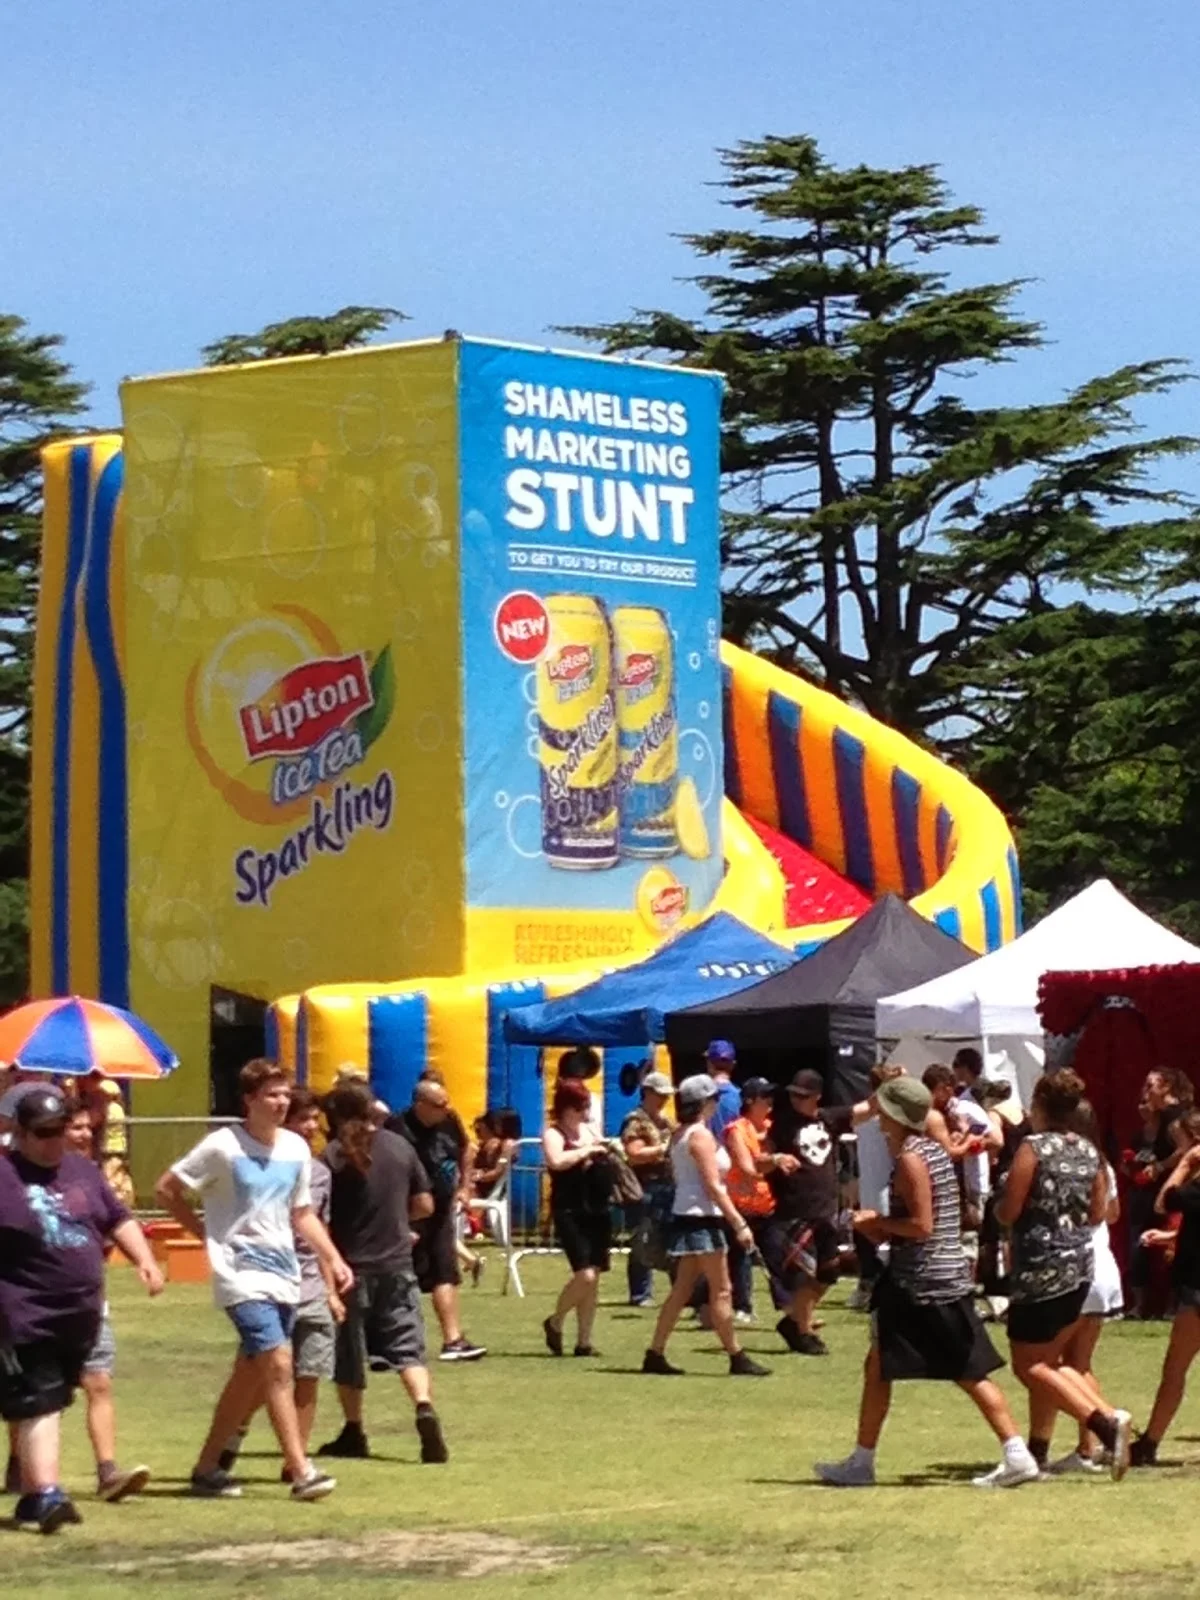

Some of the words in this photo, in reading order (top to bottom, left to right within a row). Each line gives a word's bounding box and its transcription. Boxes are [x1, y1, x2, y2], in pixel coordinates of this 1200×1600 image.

[504, 381, 688, 437] SHAMELESS
[505, 424, 691, 479] MARKETING
[504, 467, 695, 545] STUNT
[509, 551, 528, 564] TO
[531, 552, 554, 566] GET
[557, 555, 580, 569] YOU
[620, 561, 644, 575] OUR
[501, 615, 546, 643] NEW
[550, 651, 591, 678] Lipton
[250, 672, 362, 744] Lipton
[273, 755, 315, 805] Ice
[313, 729, 364, 782] Tea
[235, 770, 395, 906] Sparkling
